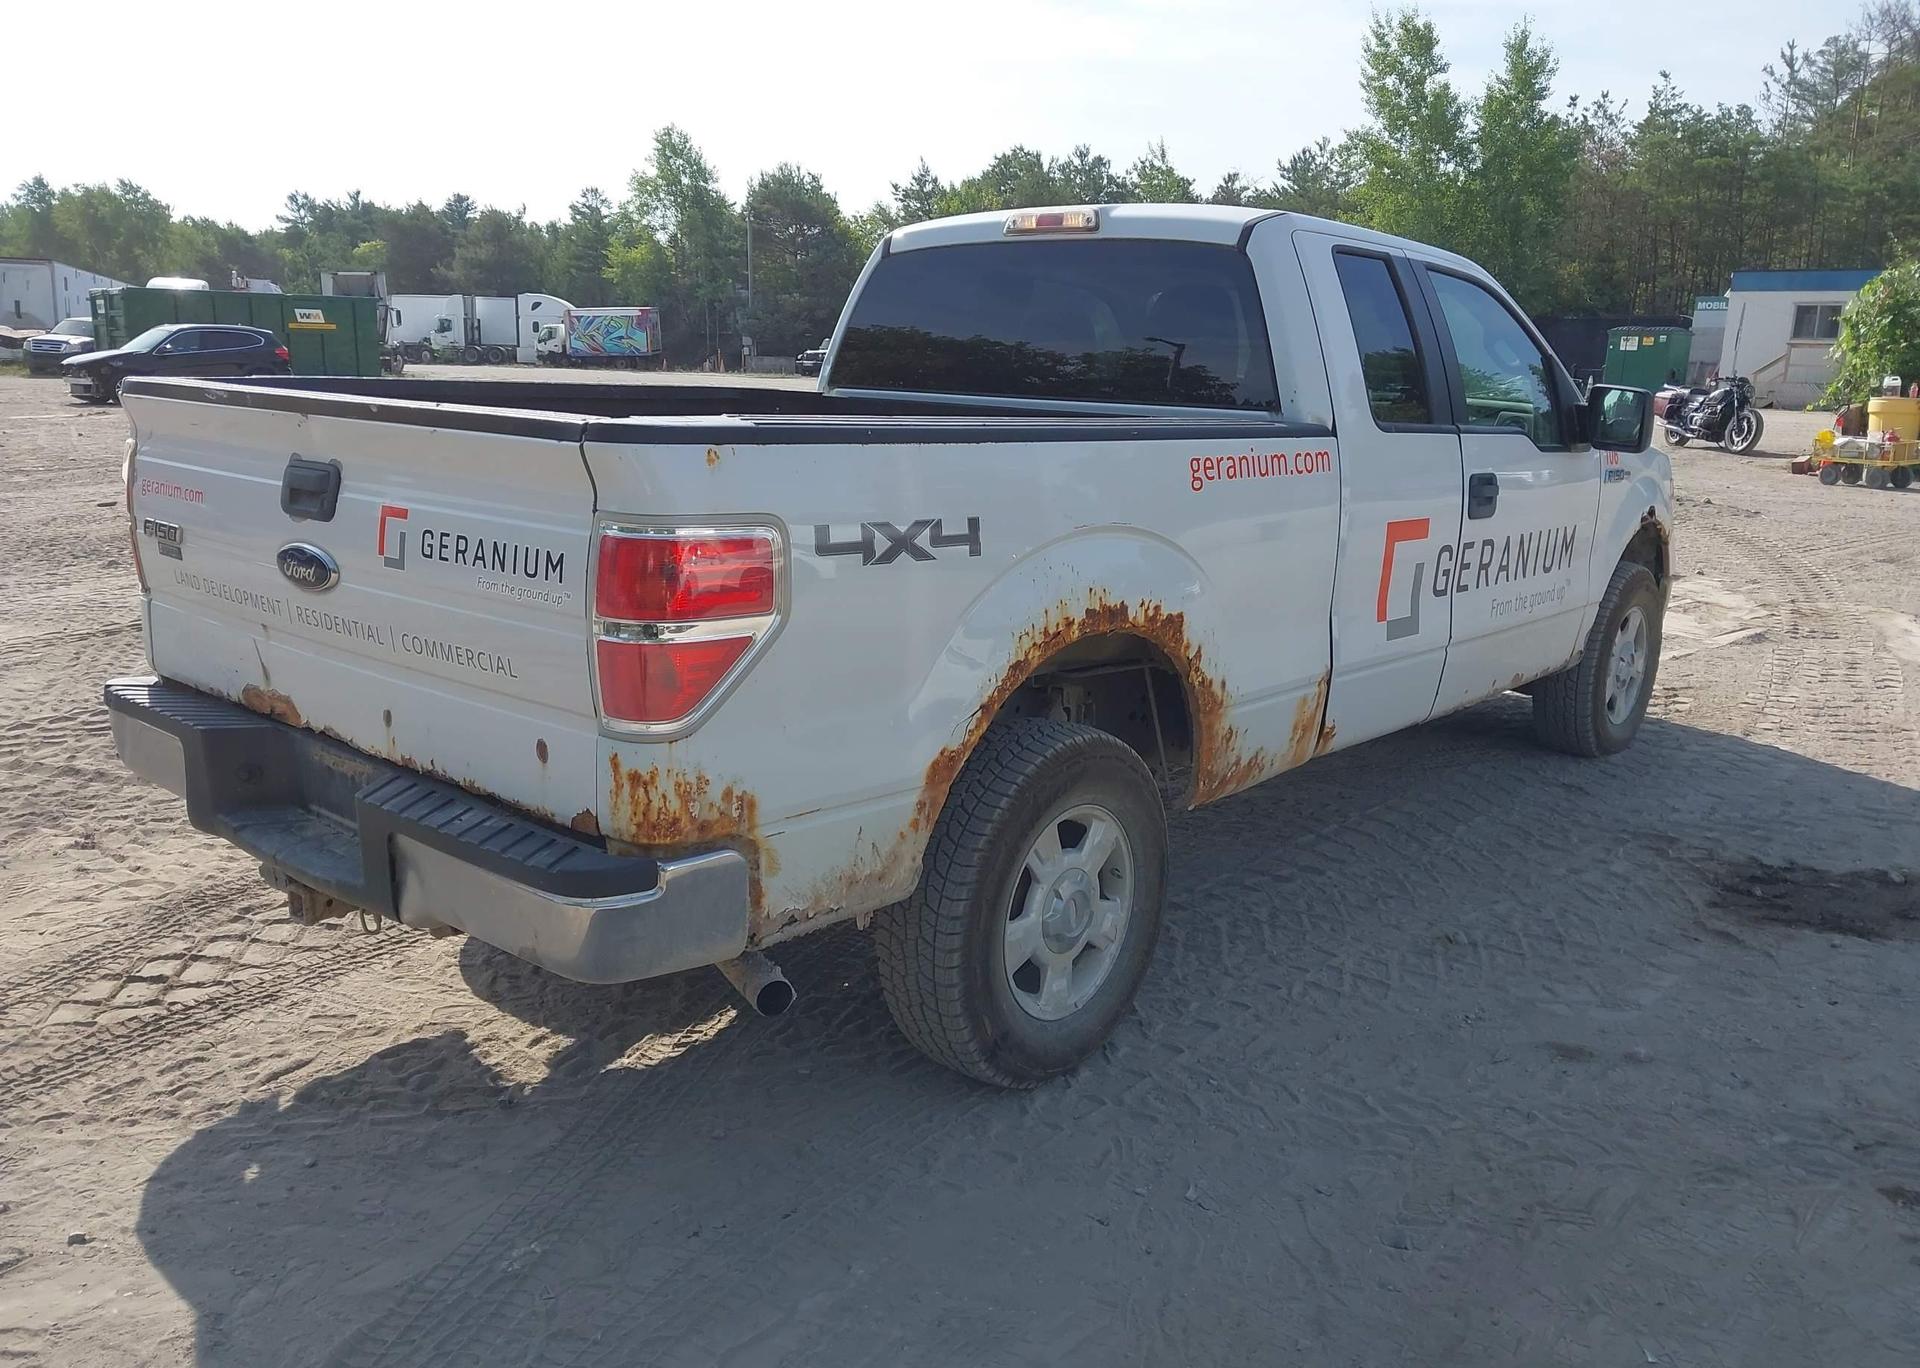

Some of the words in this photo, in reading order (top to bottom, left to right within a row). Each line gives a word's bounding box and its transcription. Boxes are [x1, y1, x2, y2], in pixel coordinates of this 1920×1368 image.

[299, 312, 321, 320] WM
[1190, 447, 1331, 492] geranium.com
[141, 478, 204, 504] geranium.com
[284, 560, 316, 582] Ford
[421, 529, 565, 584] GERANIUM
[1432, 524, 1577, 598] GERANIUM
[477, 577, 499, 592] From
[501, 582, 515, 595] the
[517, 586, 549, 602] ground
[1490, 598, 1513, 619] From
[1514, 590, 1528, 612] the
[1529, 583, 1556, 614] ground
[174, 568, 201, 591] LAND
[202, 577, 282, 617] DEVELOPMENT
[296, 605, 385, 646] RESIDENTIAL
[401, 633, 518, 679] COMMERCIAL
